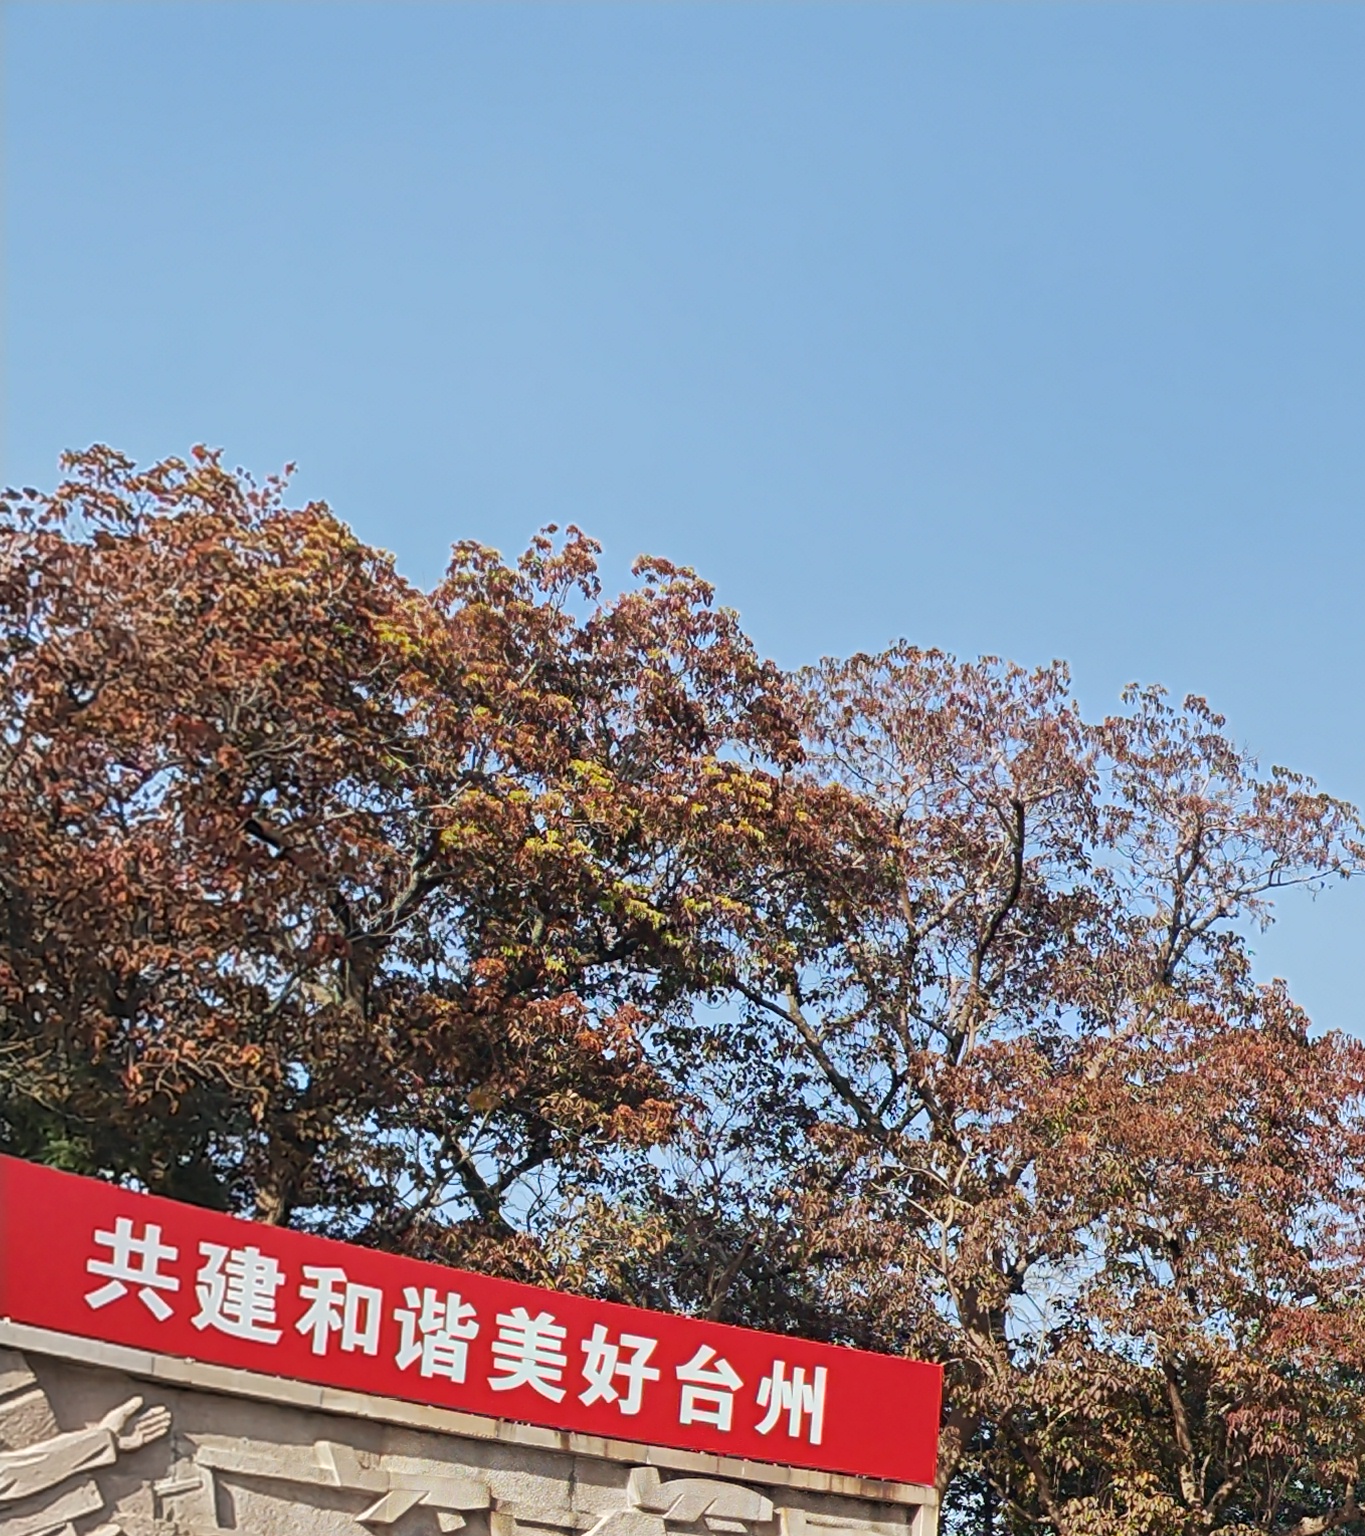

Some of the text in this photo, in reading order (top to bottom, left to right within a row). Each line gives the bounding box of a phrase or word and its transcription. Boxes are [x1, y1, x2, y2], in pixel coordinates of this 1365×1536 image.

[84, 1216, 829, 1446] 共建和谐美好台州
